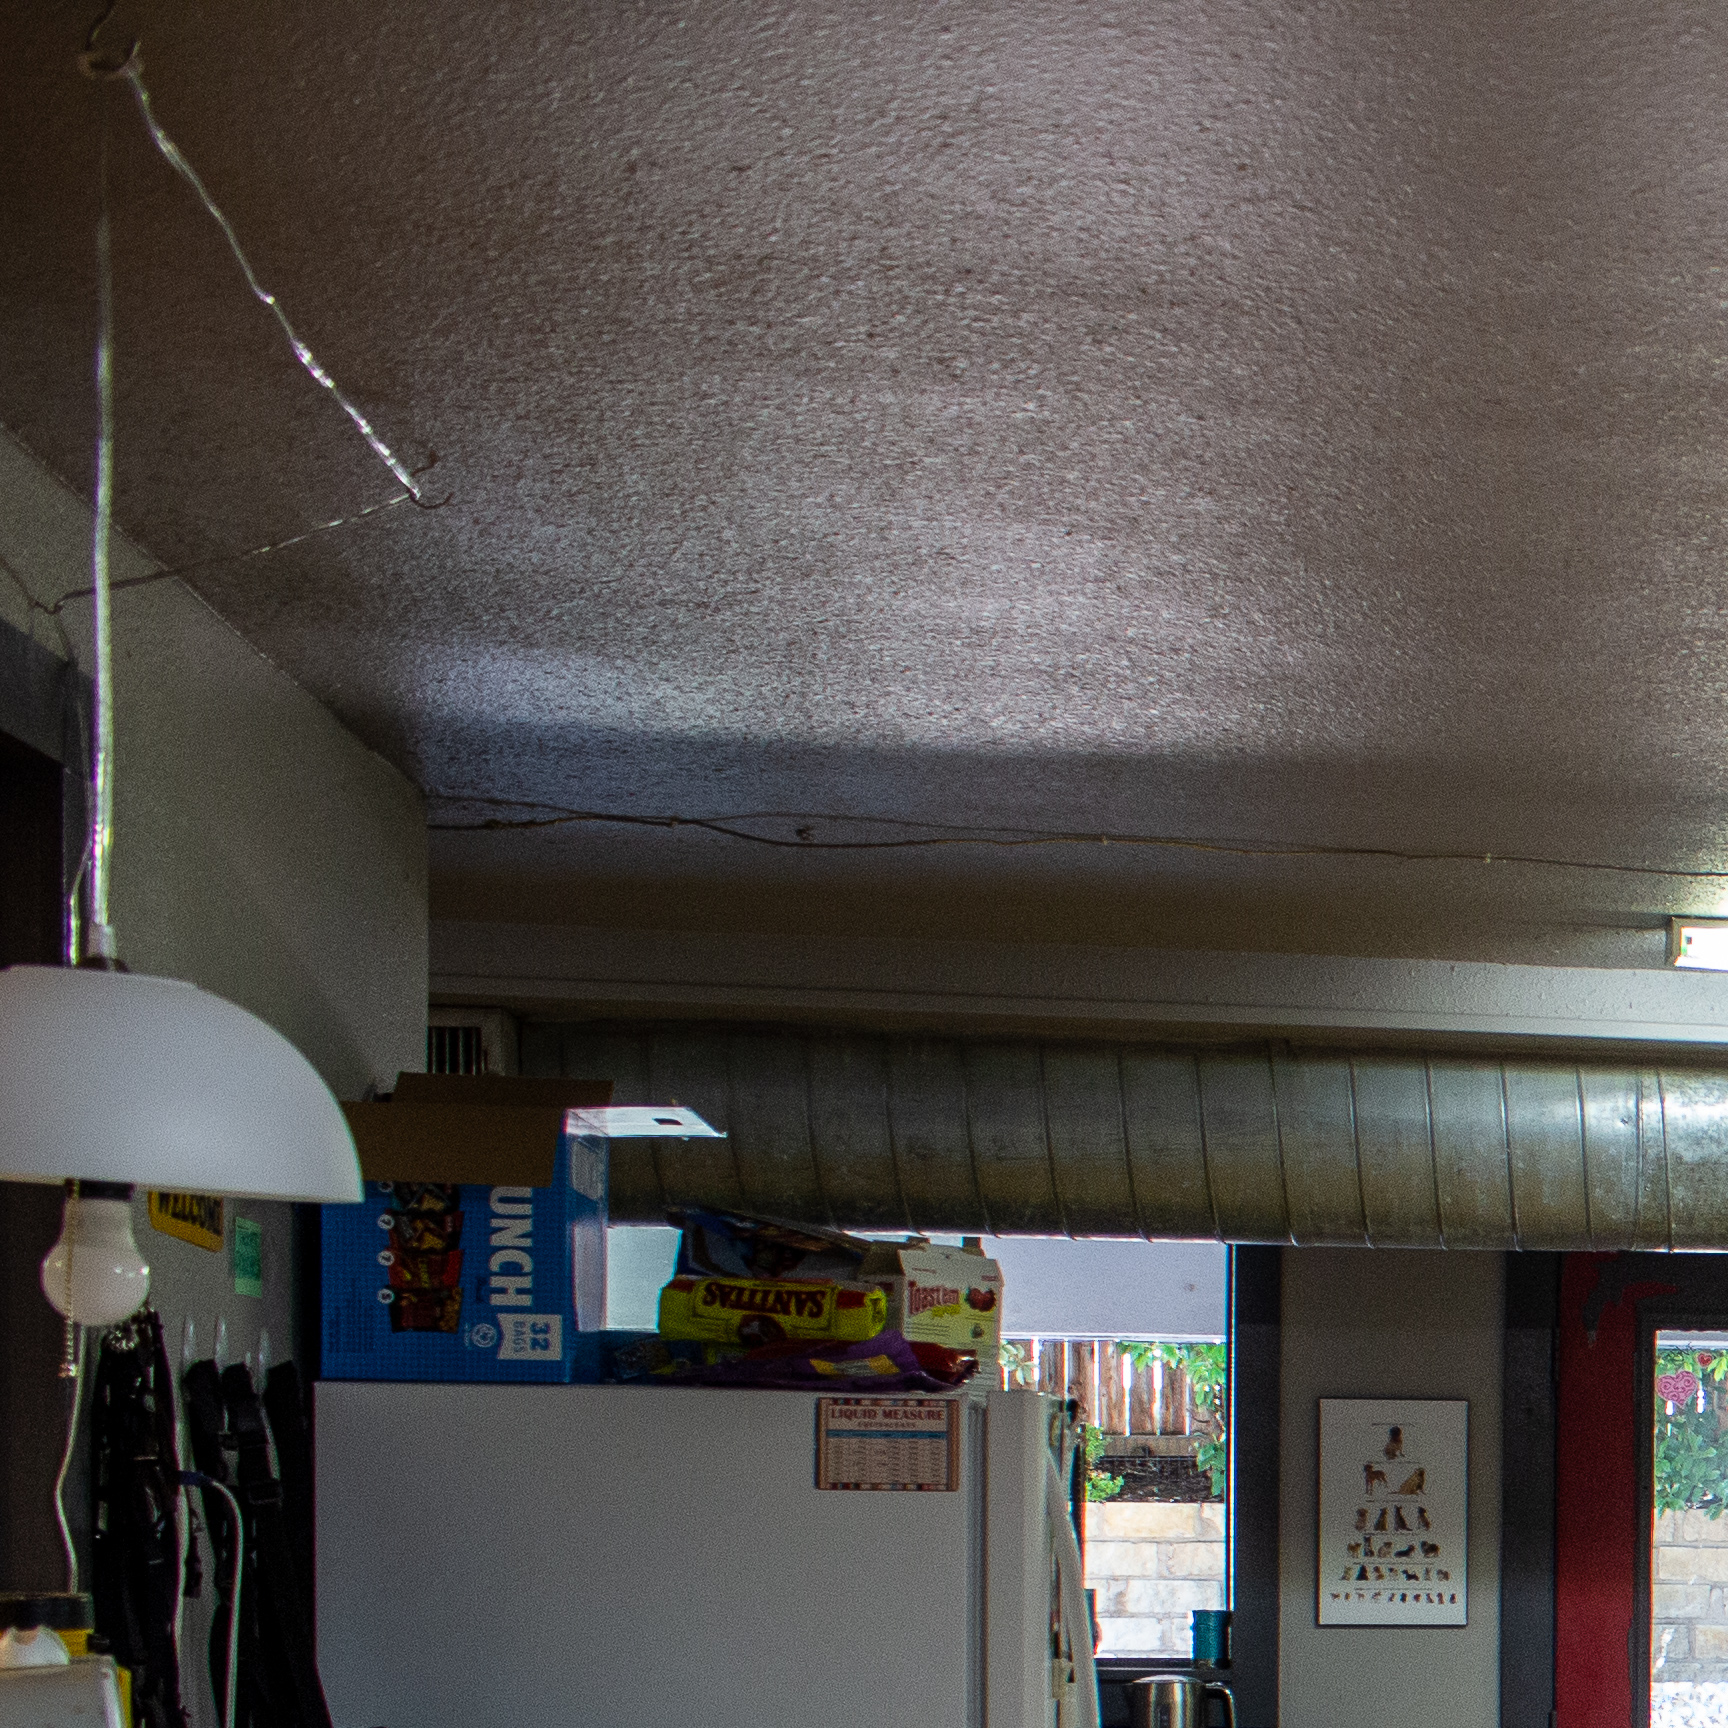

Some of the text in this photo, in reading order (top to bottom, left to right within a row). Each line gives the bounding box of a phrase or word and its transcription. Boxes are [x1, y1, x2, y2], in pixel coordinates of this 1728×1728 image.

[489, 1186, 533, 1306] UNCH
[703, 1281, 826, 1318] SANTITAS
[530, 1321, 550, 1352] 32
[831, 1408, 945, 1421] LIQUID MEASURE
